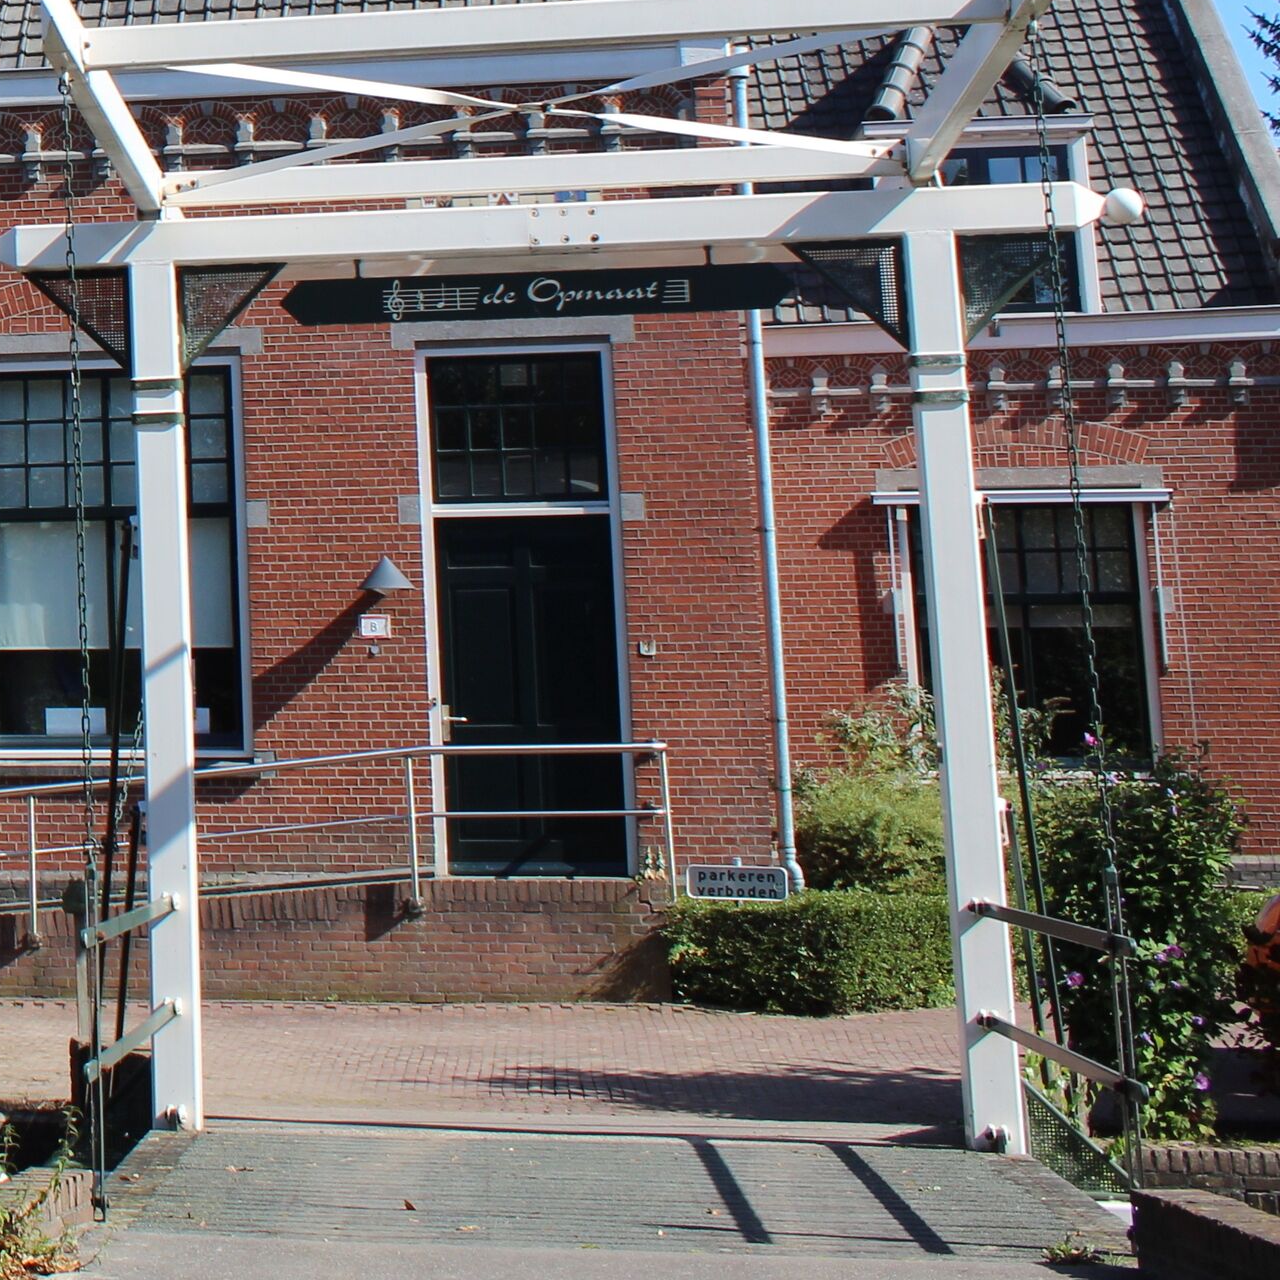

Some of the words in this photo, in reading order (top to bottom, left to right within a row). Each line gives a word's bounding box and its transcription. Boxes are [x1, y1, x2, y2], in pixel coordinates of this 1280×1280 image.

[482, 283, 516, 305] de
[526, 276, 659, 311] Opmaat
[698, 869, 775, 882] parkeren
[696, 885, 778, 898] verboden
